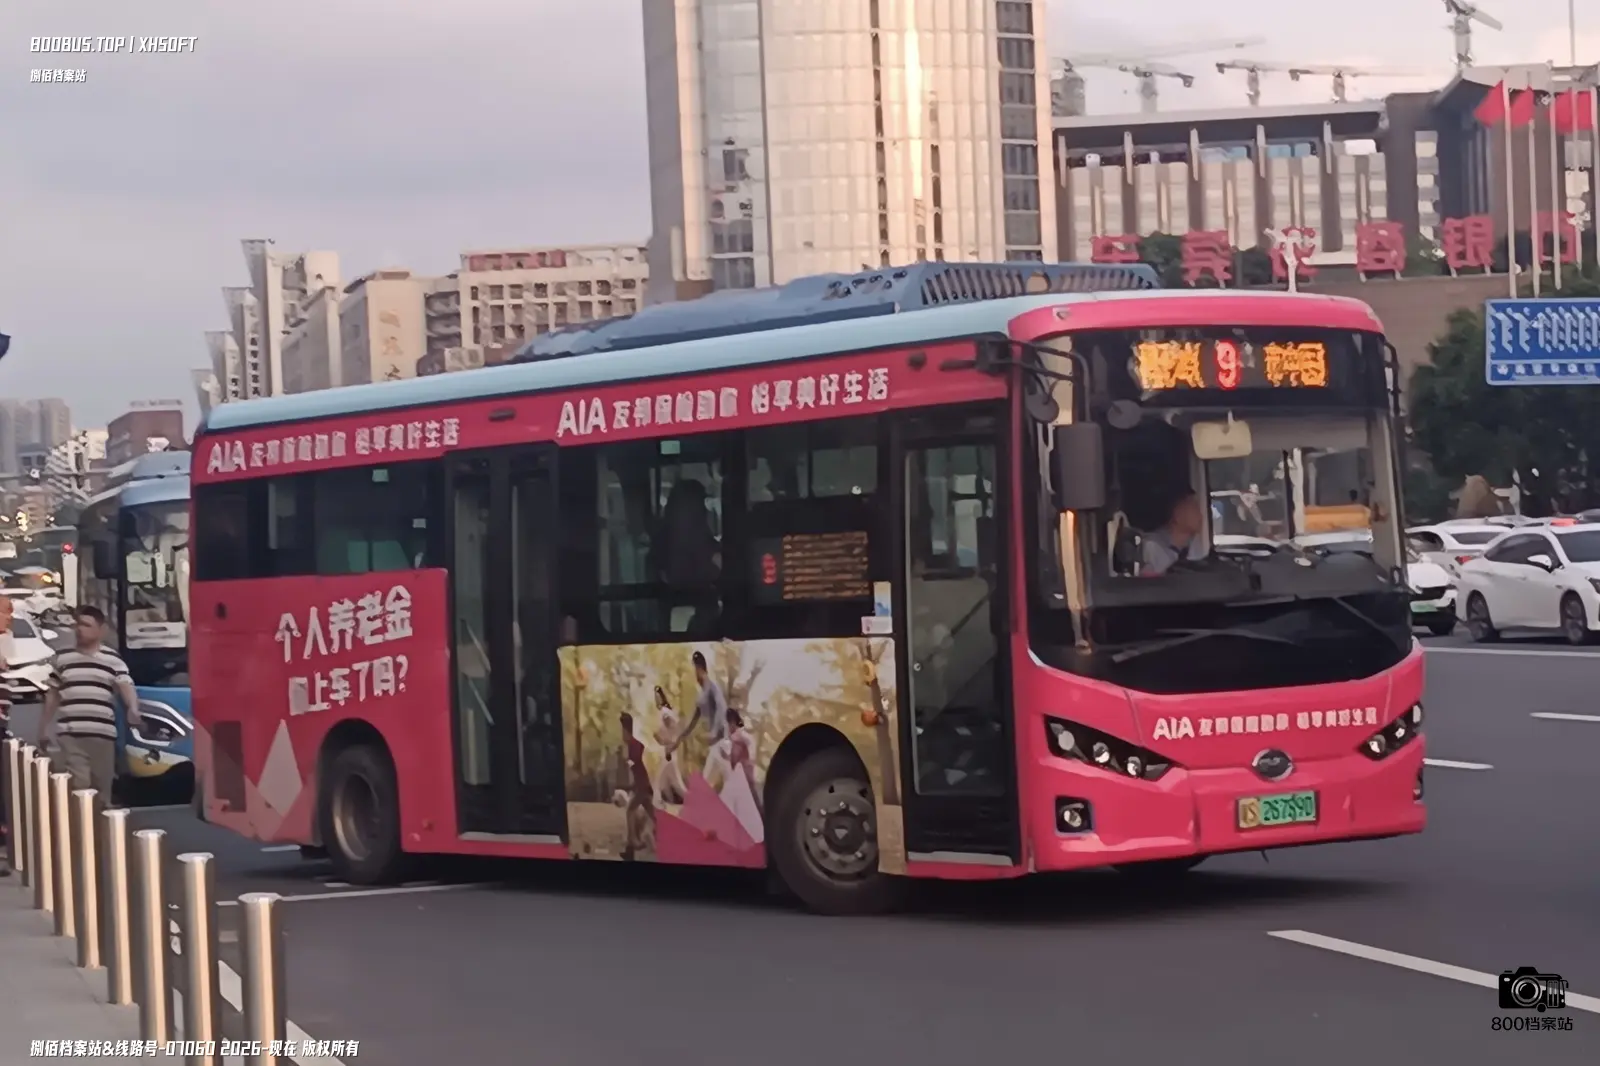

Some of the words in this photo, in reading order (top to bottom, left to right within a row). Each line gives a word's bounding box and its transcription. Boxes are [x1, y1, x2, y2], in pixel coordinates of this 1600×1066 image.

[1214, 339, 1239, 389] 9
[556, 397, 608, 438] AIA
[207, 440, 247, 475] AIA
[275, 584, 413, 664] 个人养老金
[1152, 716, 1195, 741] AIA
